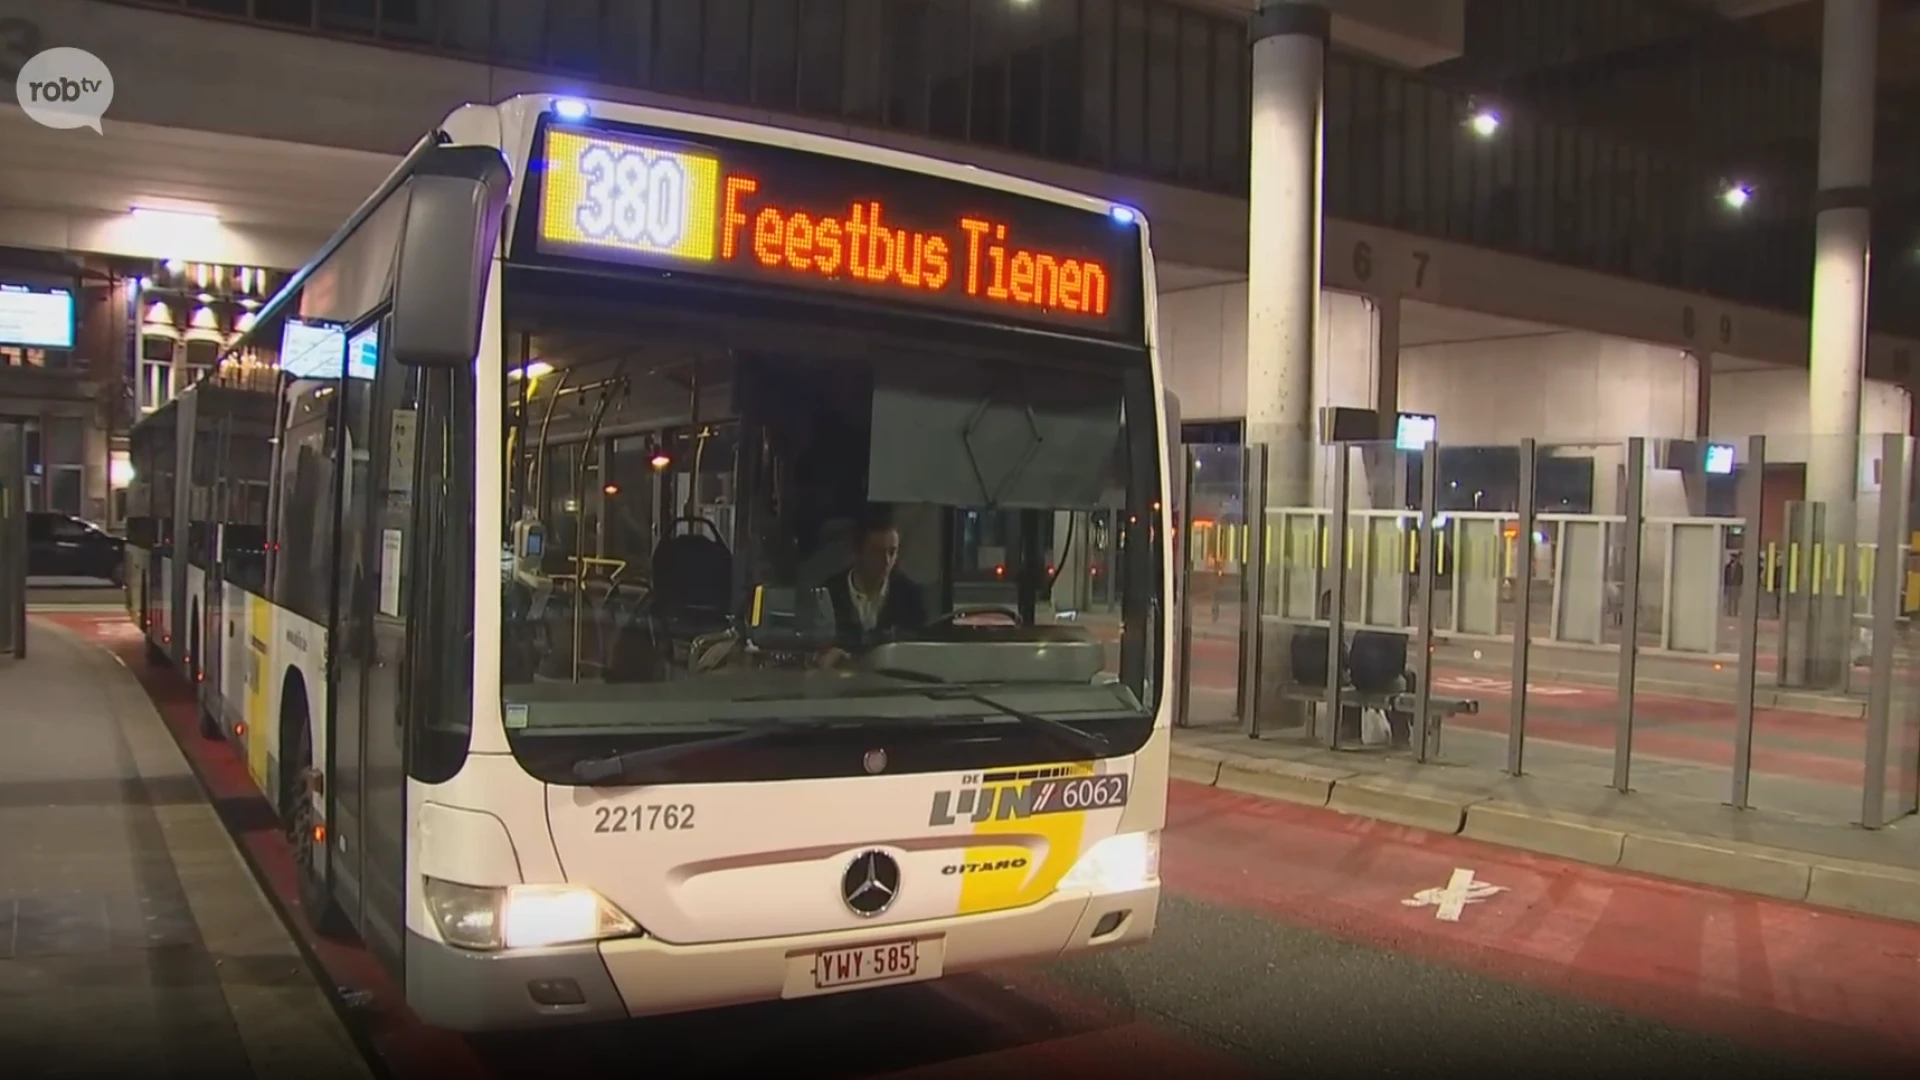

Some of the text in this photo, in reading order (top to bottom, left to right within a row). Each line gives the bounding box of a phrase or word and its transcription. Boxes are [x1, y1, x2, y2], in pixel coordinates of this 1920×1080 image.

[576, 143, 684, 248] 380
[721, 175, 1106, 315] Feestbus Tienen
[1353, 241, 1372, 282] 6
[1412, 250, 1430, 289] 7
[961, 774, 980, 785] DE
[1062, 777, 1123, 809] 6062
[594, 803, 696, 834] 221762
[941, 858, 1028, 876] CITARO
